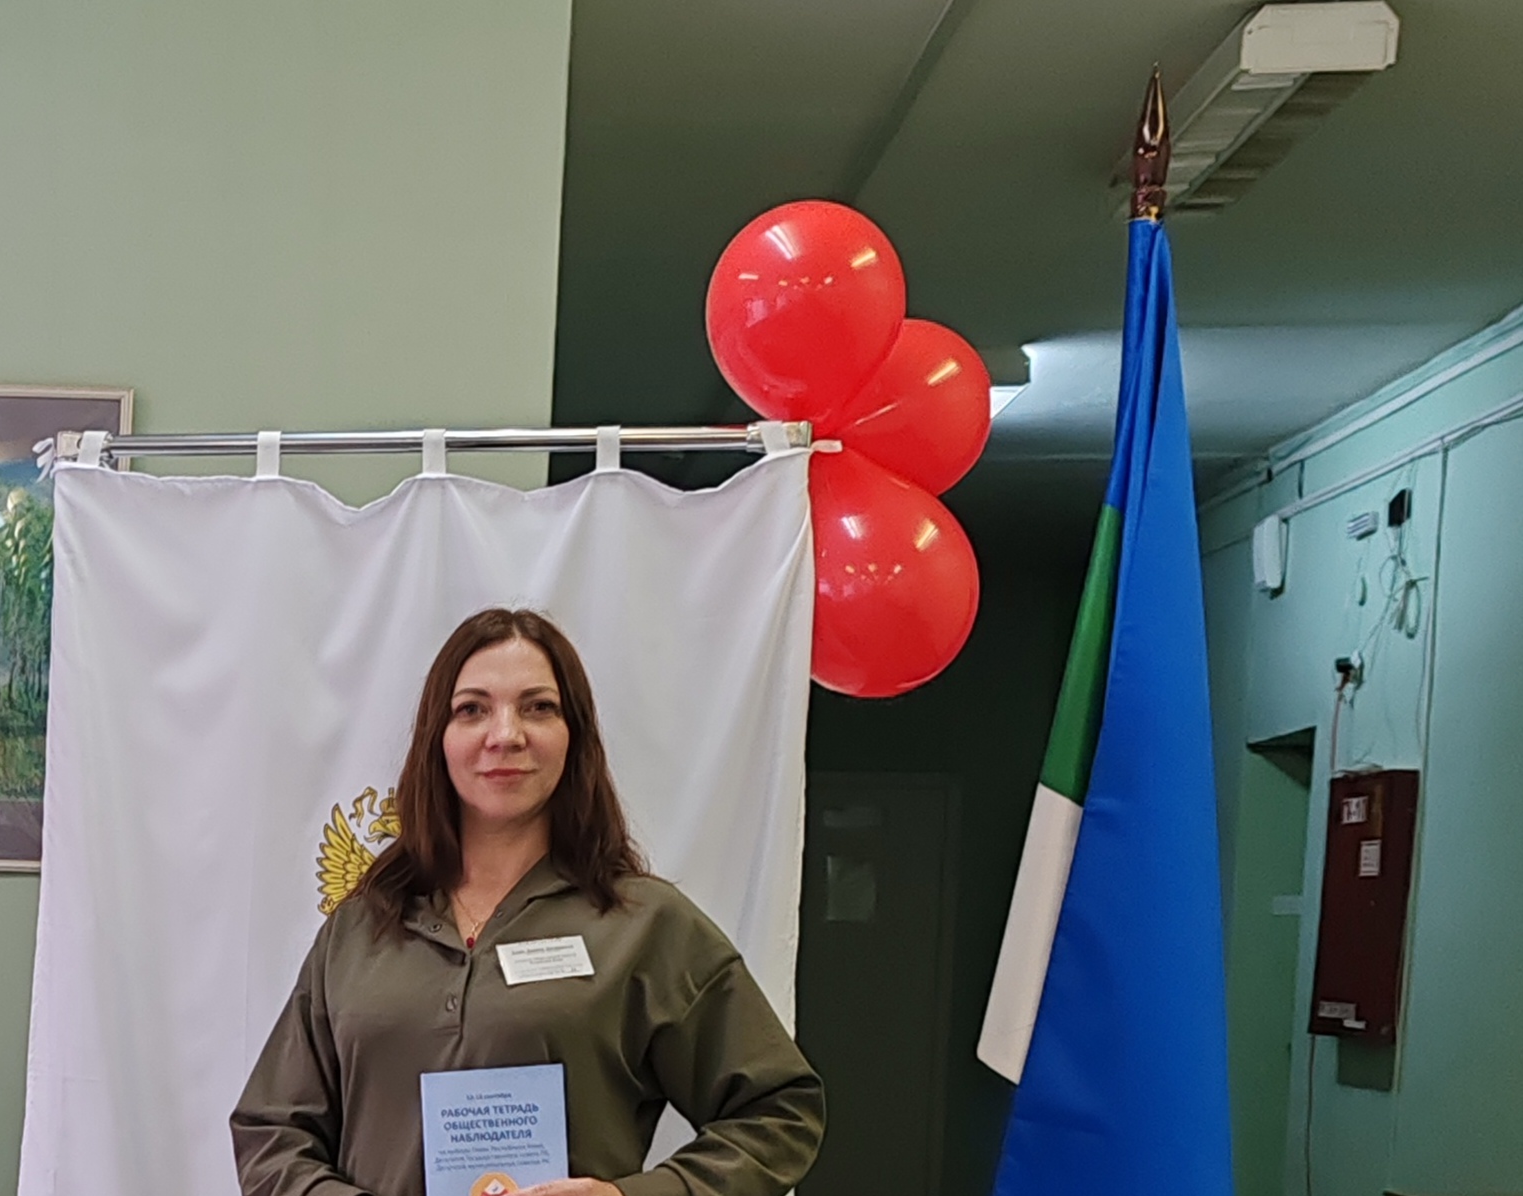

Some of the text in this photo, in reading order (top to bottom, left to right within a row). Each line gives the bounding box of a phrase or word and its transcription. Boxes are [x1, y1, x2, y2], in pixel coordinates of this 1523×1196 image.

[441, 1103, 539, 1118] РАБОЧАЯ ТЕТРАДЬ
[443, 1115, 538, 1132] ОБЩЕСТВЕННОГО
[451, 1129, 532, 1143] НАБЛЮДАТЕЛЯ
